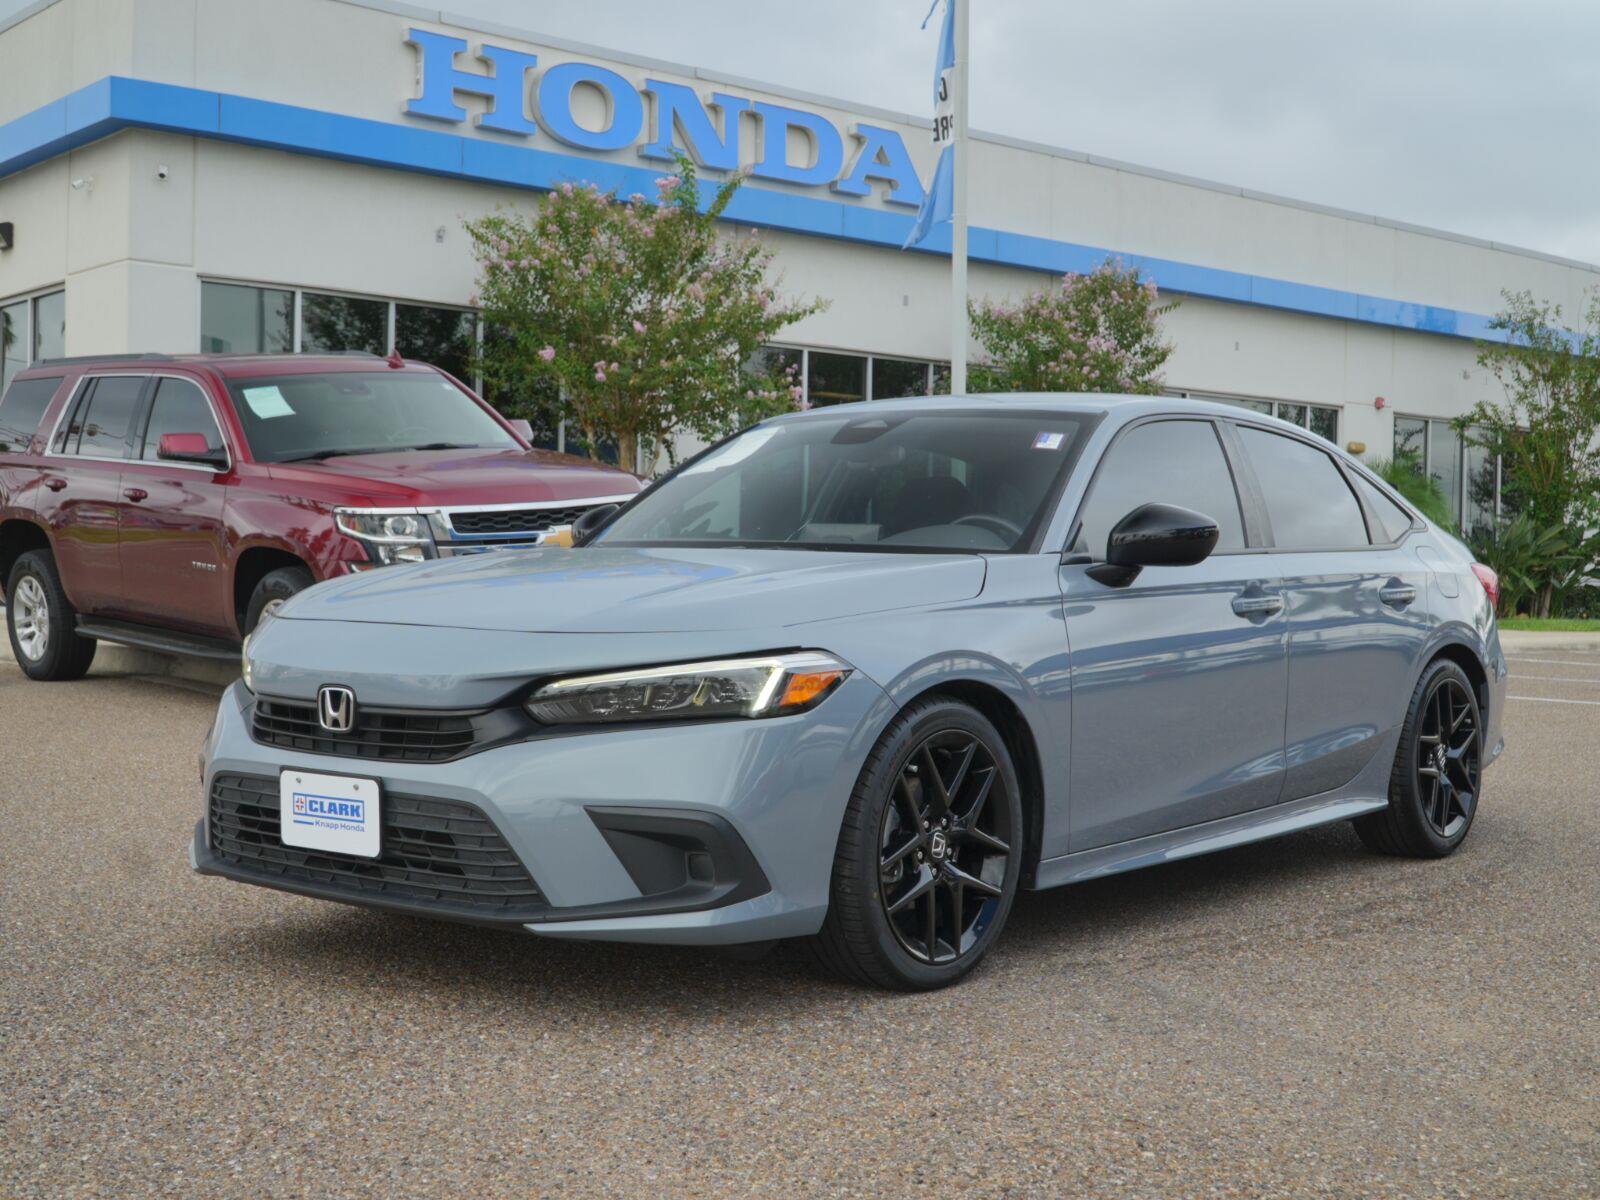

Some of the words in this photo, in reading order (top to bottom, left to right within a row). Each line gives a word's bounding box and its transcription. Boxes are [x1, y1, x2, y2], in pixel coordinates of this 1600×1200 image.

[403, 27, 930, 209] HONDA
[309, 799, 360, 818] CLARK
[315, 820, 339, 830] Knapp
[340, 822, 364, 832] Honda
